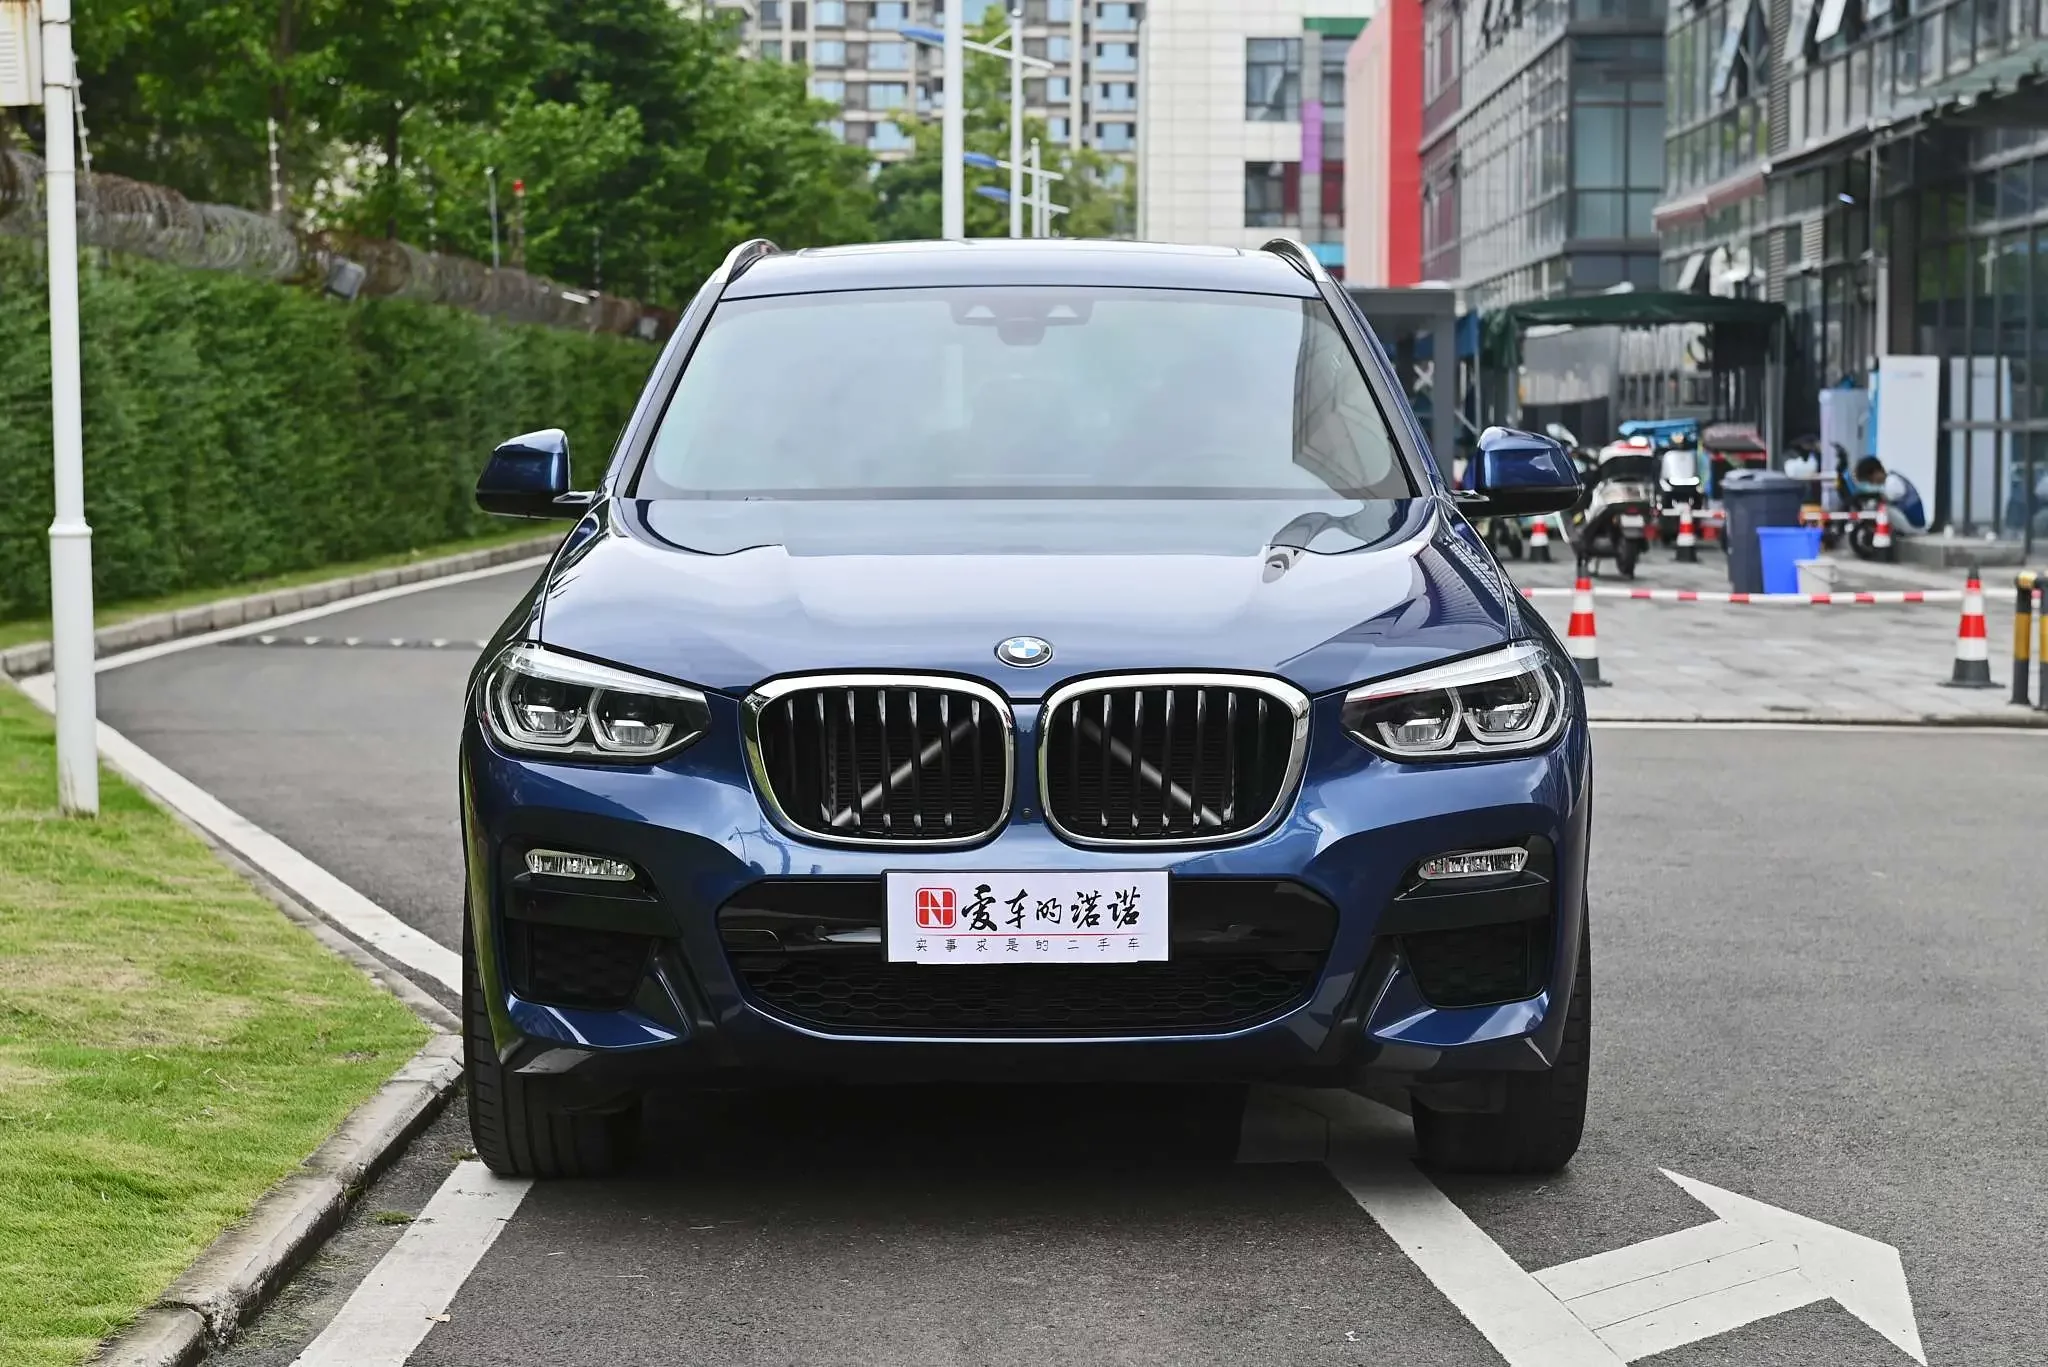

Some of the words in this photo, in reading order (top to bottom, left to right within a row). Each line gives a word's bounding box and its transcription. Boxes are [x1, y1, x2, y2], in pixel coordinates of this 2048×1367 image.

[915, 937, 1140, 953] 实事求是的二手车
